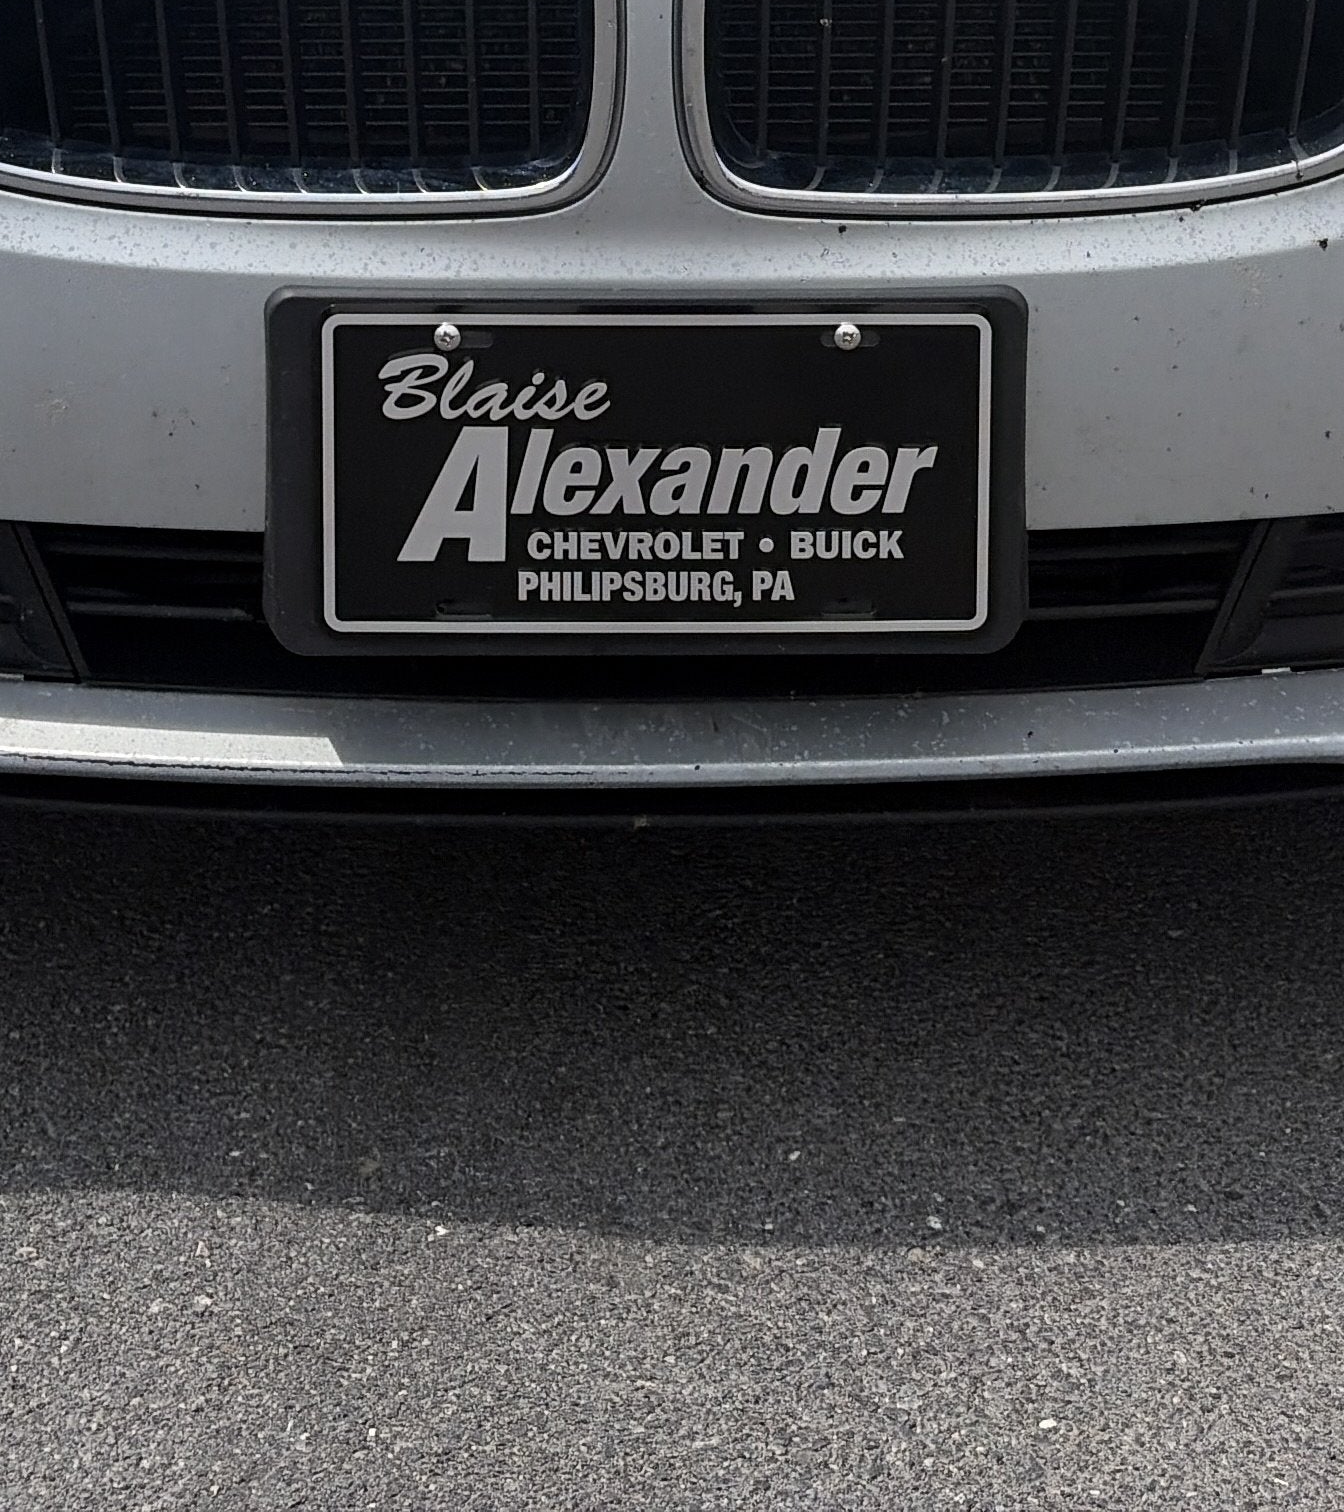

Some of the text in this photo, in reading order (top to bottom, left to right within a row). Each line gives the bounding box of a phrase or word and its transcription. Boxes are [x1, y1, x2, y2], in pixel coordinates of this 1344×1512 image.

[377, 352, 612, 422] Blaise
[396, 425, 939, 563] Alexander
[526, 529, 905, 561] CHEVROLET BUICK
[516, 569, 796, 609] PHILIPSBURG, PA
